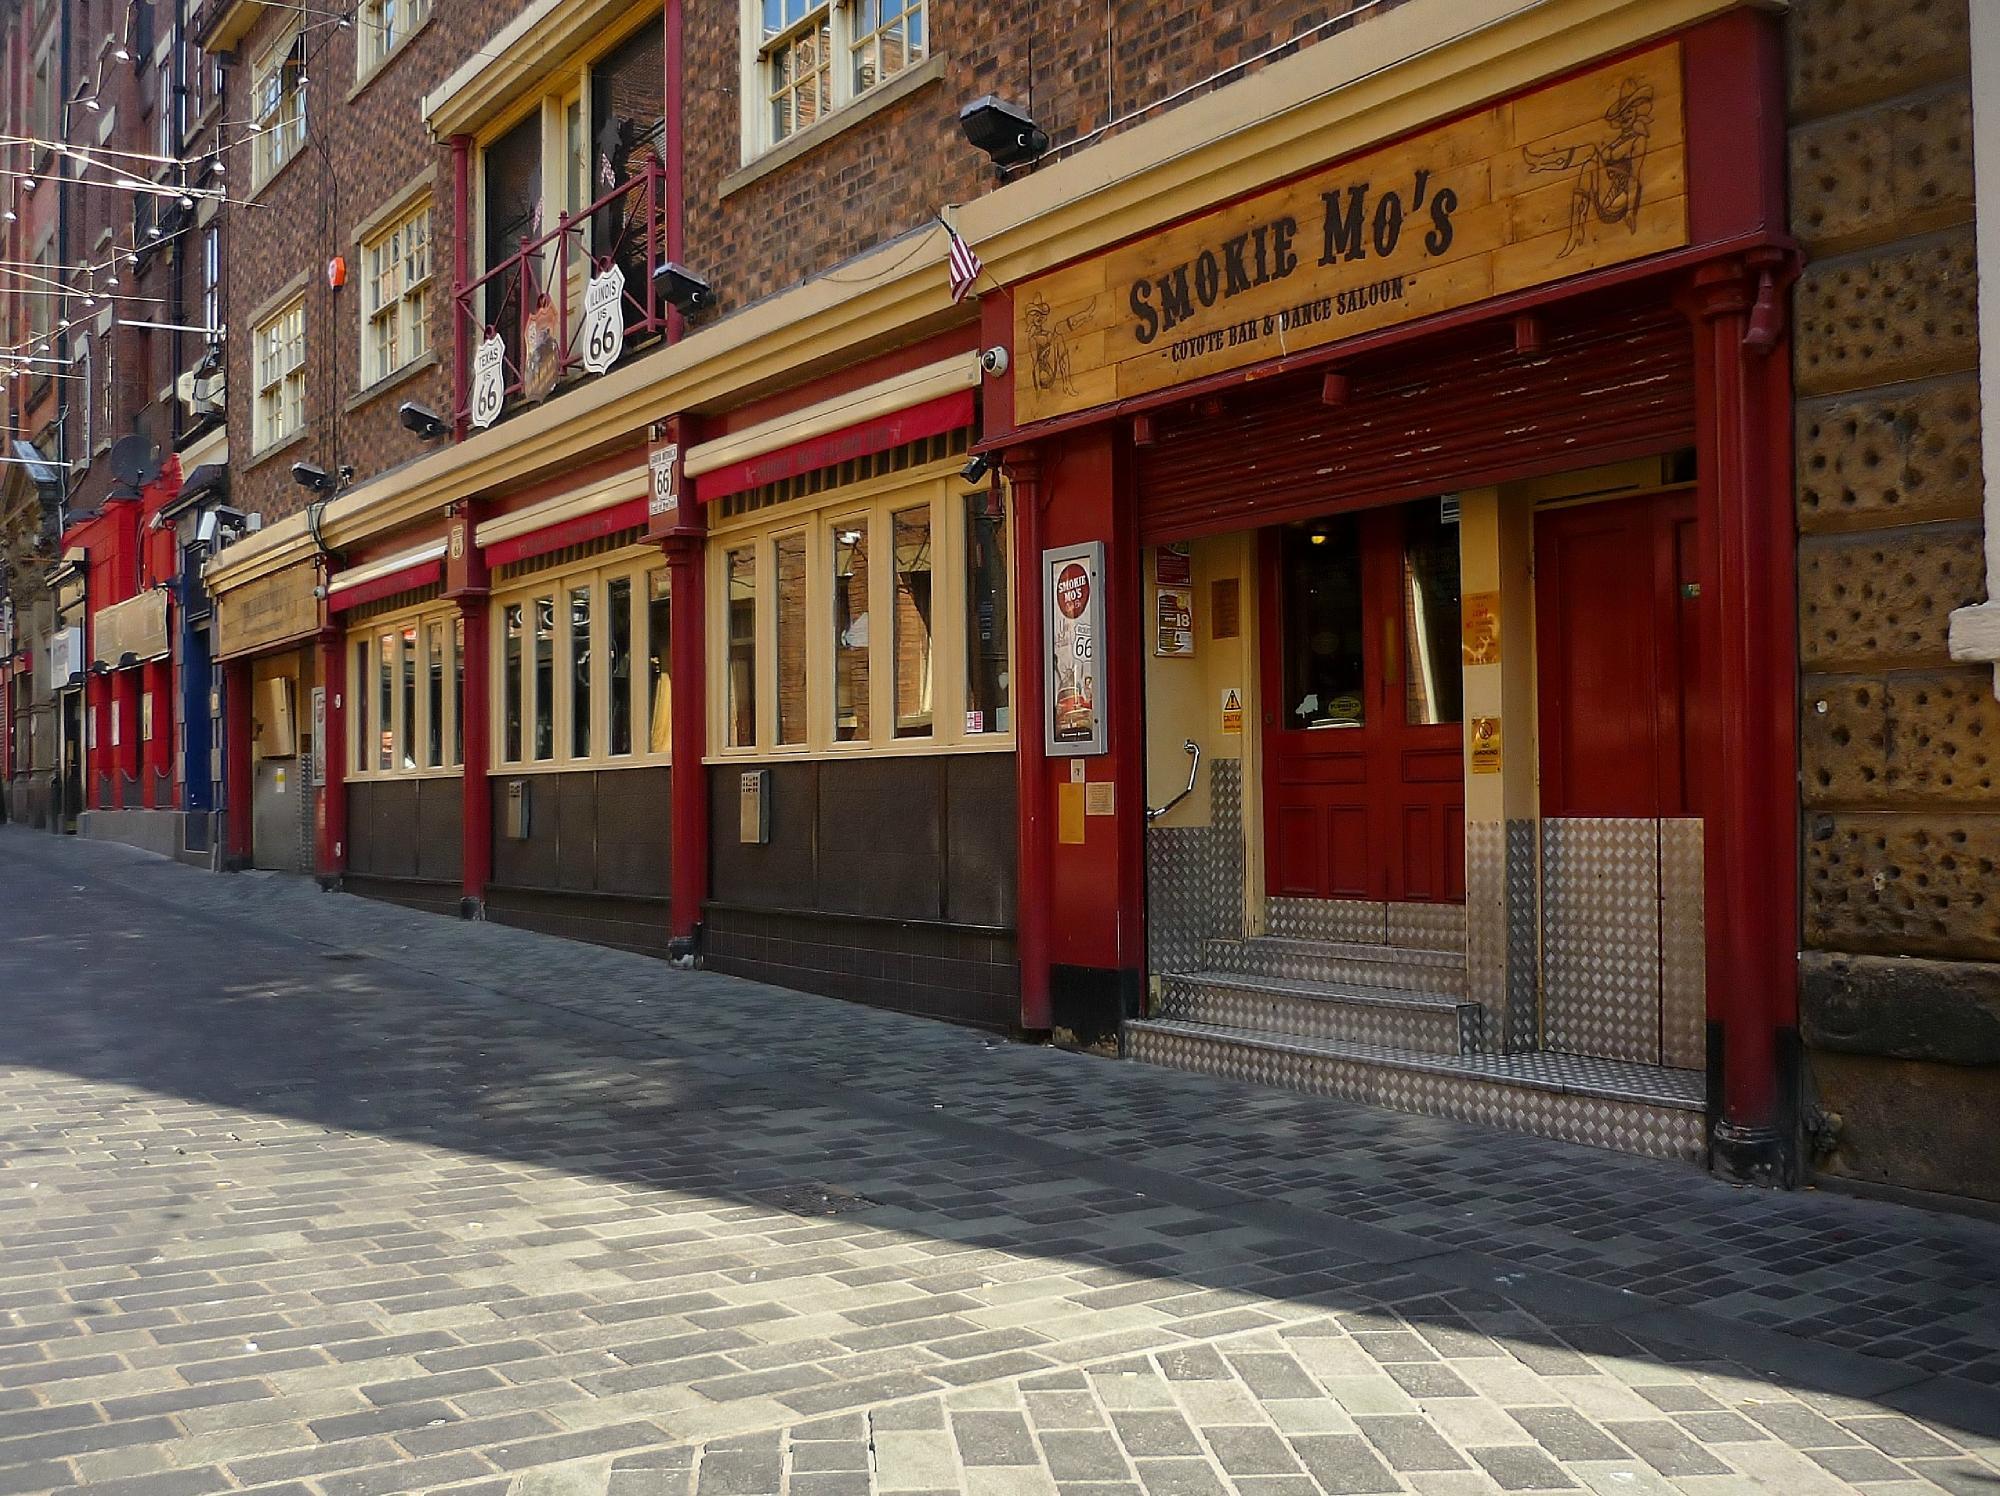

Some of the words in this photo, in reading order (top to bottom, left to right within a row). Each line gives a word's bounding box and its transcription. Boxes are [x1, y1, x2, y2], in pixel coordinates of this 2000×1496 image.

[1130, 216, 1298, 344] SMOKIE
[1318, 169, 1458, 267] MO'S
[591, 280, 617, 307] ILLINOIS
[597, 308, 607, 321] US
[1172, 330, 1224, 362] COYOTE
[1229, 320, 1258, 347] BAR
[1263, 315, 1274, 336] &
[1281, 298, 1332, 331] DANCE
[1336, 277, 1403, 315] SALOON
[590, 316, 615, 360] 66
[479, 347, 499, 367] TEXAS
[478, 378, 497, 417] 66
[657, 468, 669, 496] 66
[1058, 575, 1087, 593] SMOKIE
[1176, 613, 1191, 627] 18
[1075, 637, 1092, 658] 66
